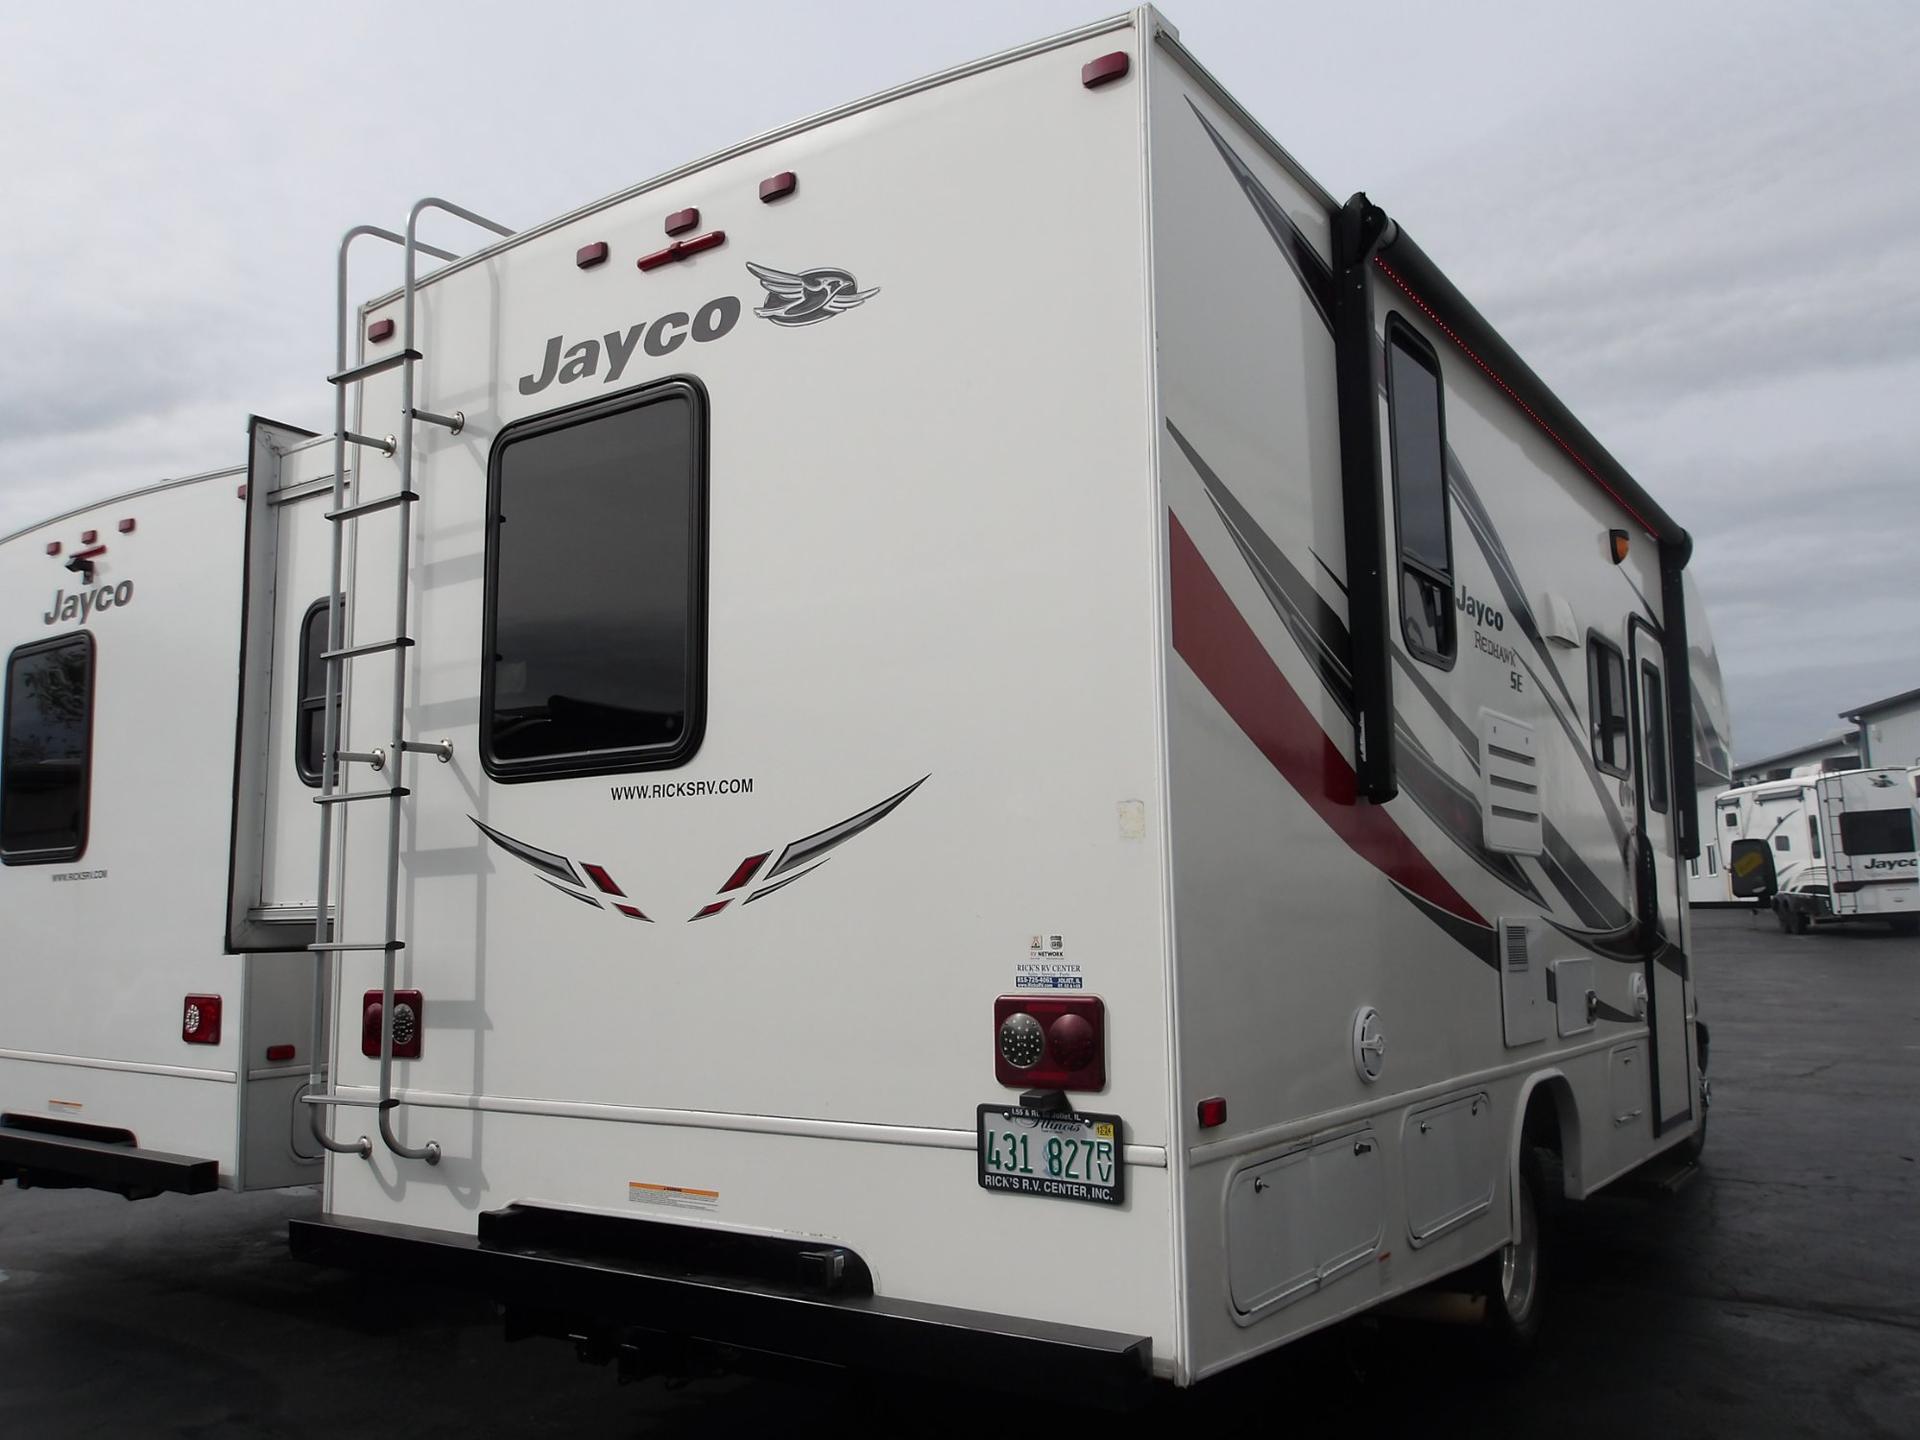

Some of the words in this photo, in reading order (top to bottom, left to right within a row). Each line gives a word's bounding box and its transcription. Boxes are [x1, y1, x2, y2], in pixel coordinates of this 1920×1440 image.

[518, 295, 741, 396] Jayco
[44, 579, 135, 625] Jayco
[1456, 585, 1504, 632] Jayco
[1474, 630, 1516, 668] REDHAWK
[1510, 671, 1523, 693] SE
[611, 778, 754, 801] WWW.RICKSRV.COM
[1017, 964, 1040, 972] RICK'S
[1041, 964, 1051, 972] RV
[1052, 964, 1081, 972] CENTER
[987, 1130, 1034, 1174] 431
[1048, 1137, 1096, 1180] 827
[985, 1175, 1020, 1190] RICK'S
[1022, 1179, 1041, 1192] R.V.
